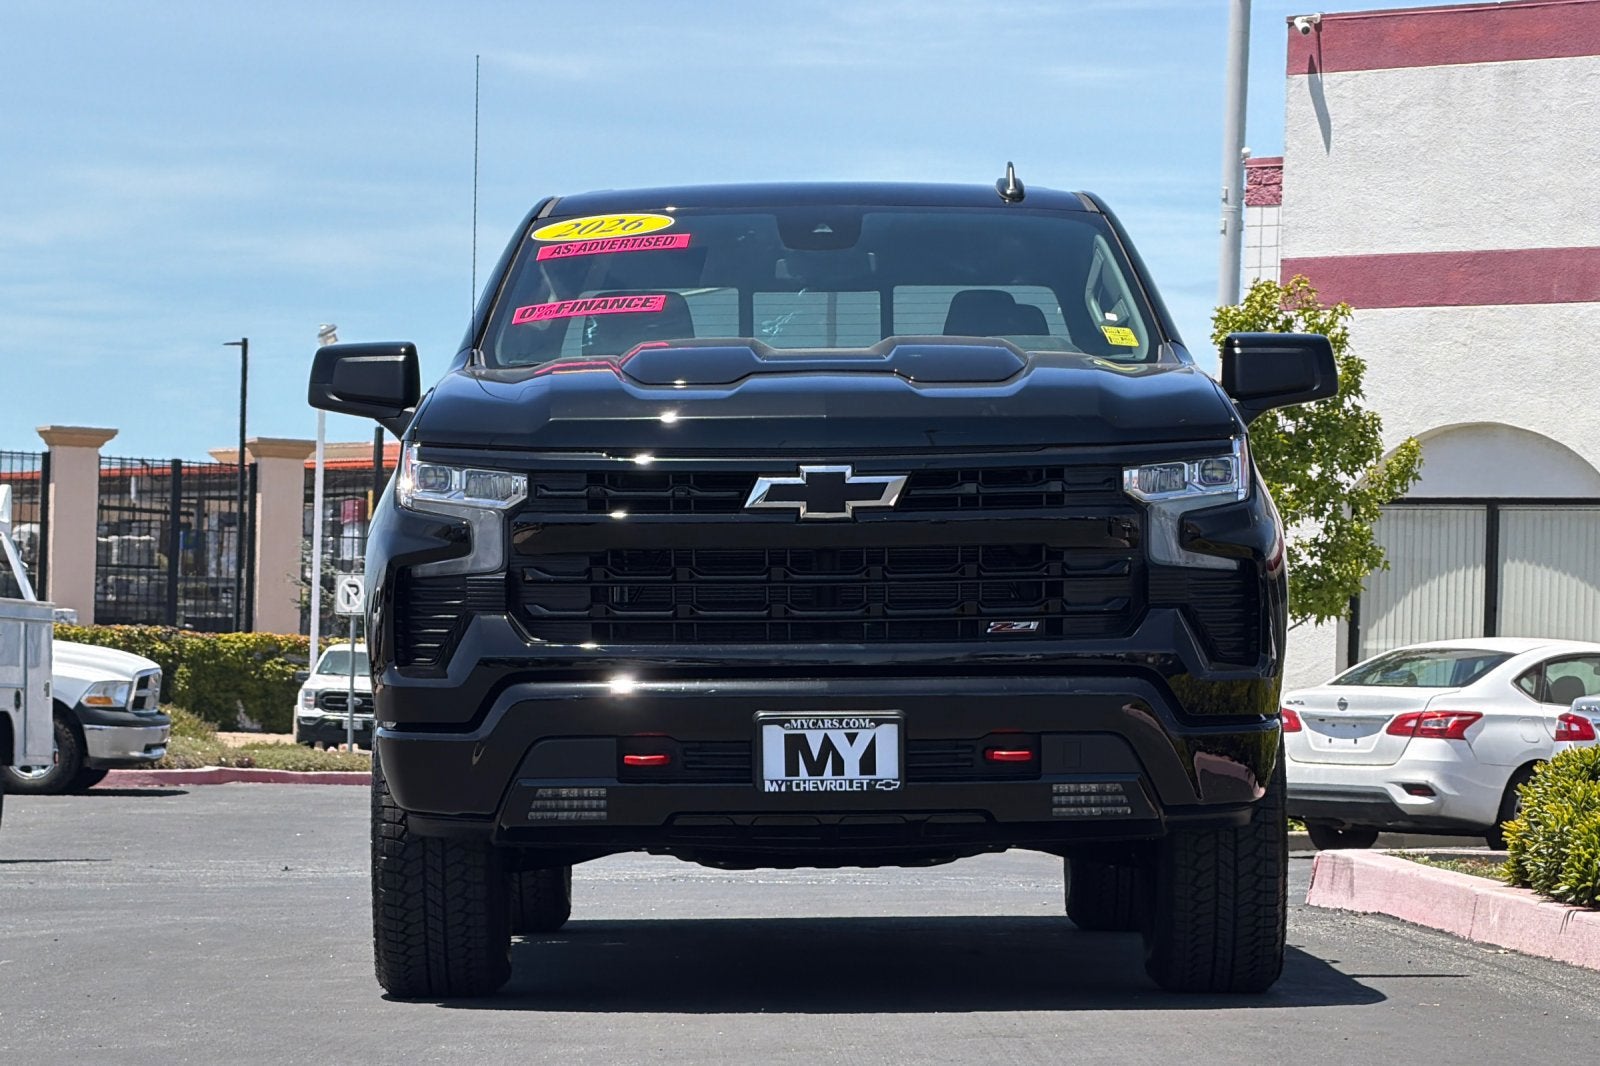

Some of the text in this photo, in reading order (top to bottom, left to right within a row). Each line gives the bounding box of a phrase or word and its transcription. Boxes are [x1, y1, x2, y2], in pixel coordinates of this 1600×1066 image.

[552, 217, 648, 238] 2026
[550, 236, 676, 256] AS ADVERTISED
[519, 296, 656, 319] 0% FINANCE
[790, 718, 870, 729] MYCARS.COM
[784, 732, 877, 777] MY
[764, 780, 870, 792] MY CHEVROLET
